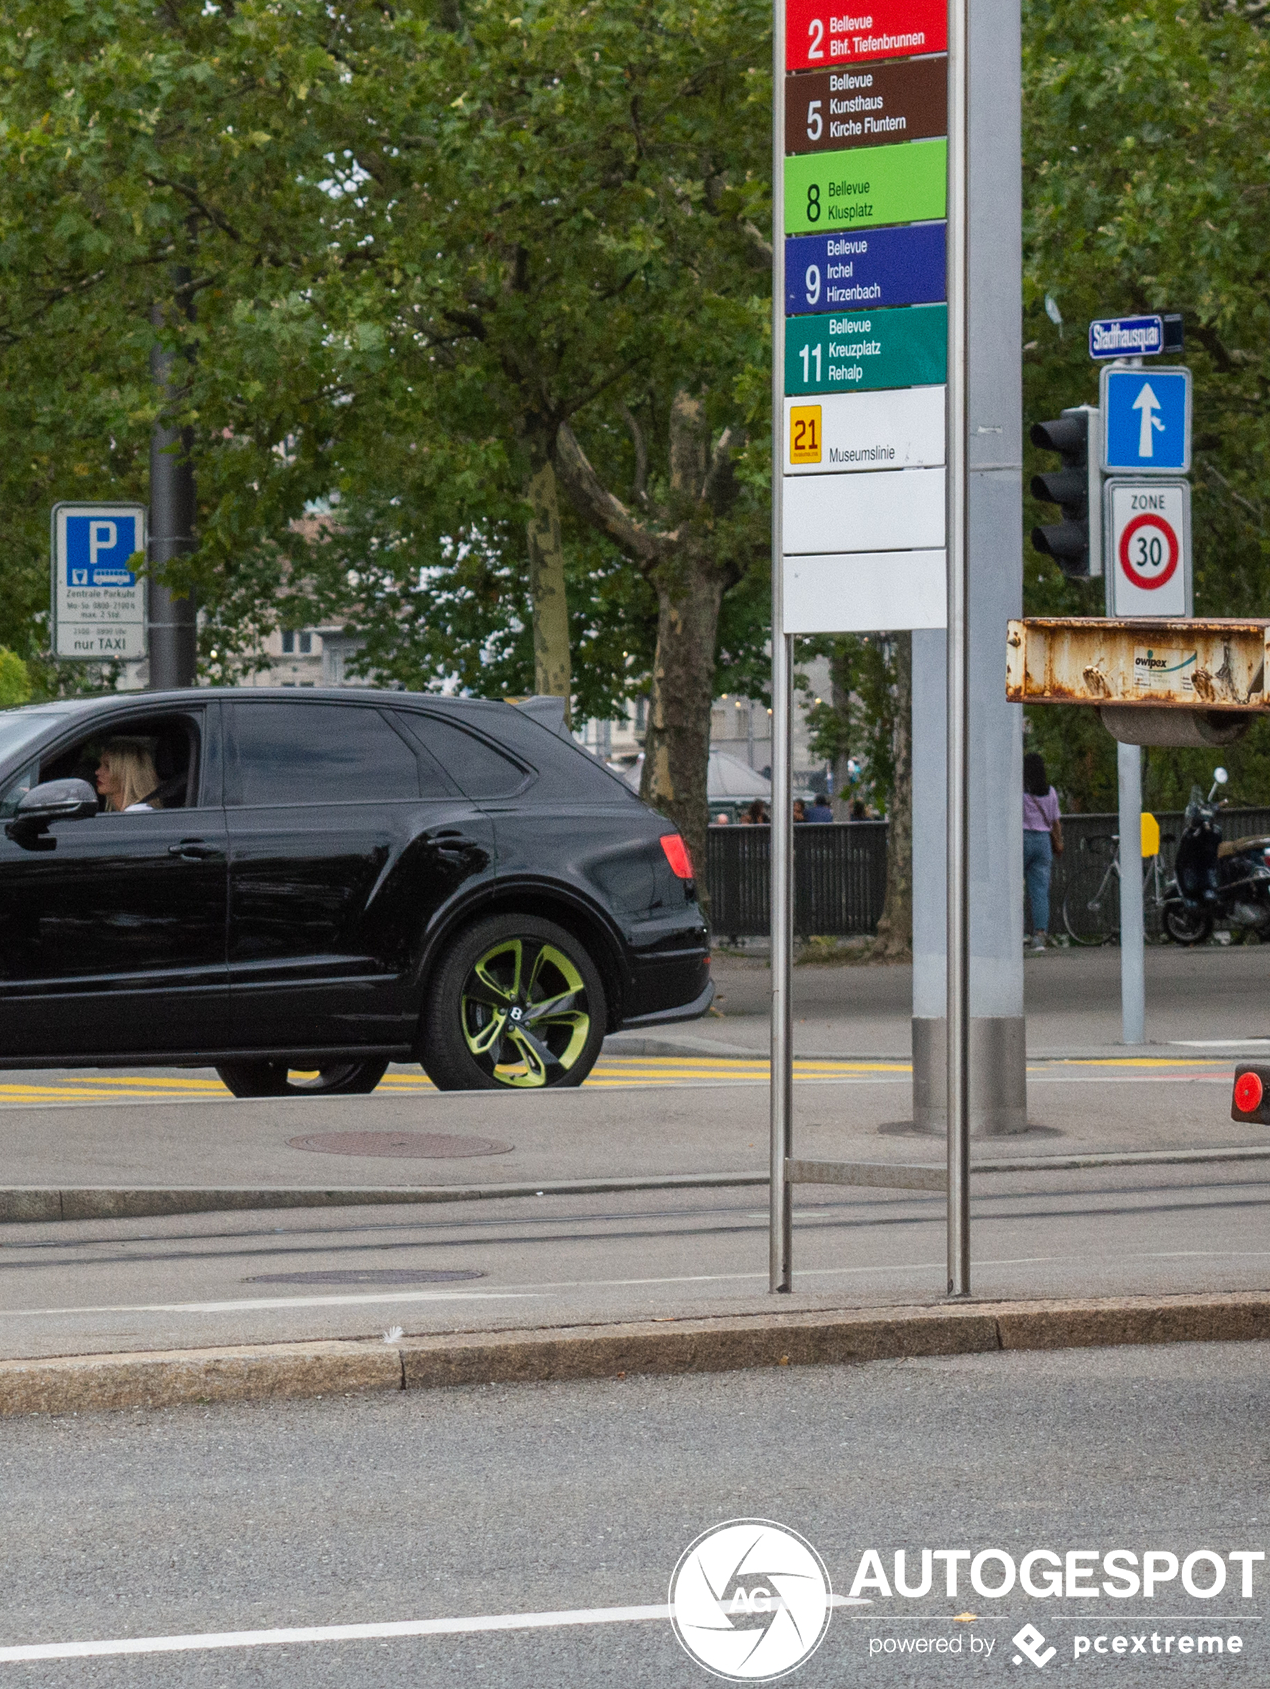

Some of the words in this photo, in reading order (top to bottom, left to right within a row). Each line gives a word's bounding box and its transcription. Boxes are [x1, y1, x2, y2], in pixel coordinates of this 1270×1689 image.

[830, 15, 873, 33] Bellevue
[808, 18, 824, 59] 2
[830, 39, 851, 57] Bhf.
[852, 32, 925, 53] Tiefenbrunnen
[830, 73, 873, 91] Bellevue
[830, 95, 884, 114] Kunsthaus
[807, 100, 823, 140] 5
[830, 119, 862, 137] Kirche
[864, 115, 906, 133] Fluntern
[828, 181, 870, 197] Bellevue
[807, 184, 821, 222] 8
[828, 203, 873, 221] Klusplatz
[827, 239, 868, 256] Bellevue
[827, 261, 853, 279] Irchel
[806, 264, 821, 305] 9
[827, 283, 881, 302] Hirzenbach
[829, 318, 872, 334] Bellevue
[1093, 319, 1159, 352] Stadthausquai
[829, 340, 881, 359] Kreuzplatz
[799, 343, 822, 382] 11
[828, 364, 863, 382] Rehalp
[794, 419, 818, 450] 21
[829, 445, 895, 463] Museumslinie
[1131, 495, 1166, 510] ZONE
[90, 521, 117, 564] P
[1136, 537, 1162, 567] 30
[67, 590, 101, 598] Zentrale
[74, 641, 94, 650] nur
[98, 638, 126, 650] TAXI
[1135, 650, 1167, 669] owipex
